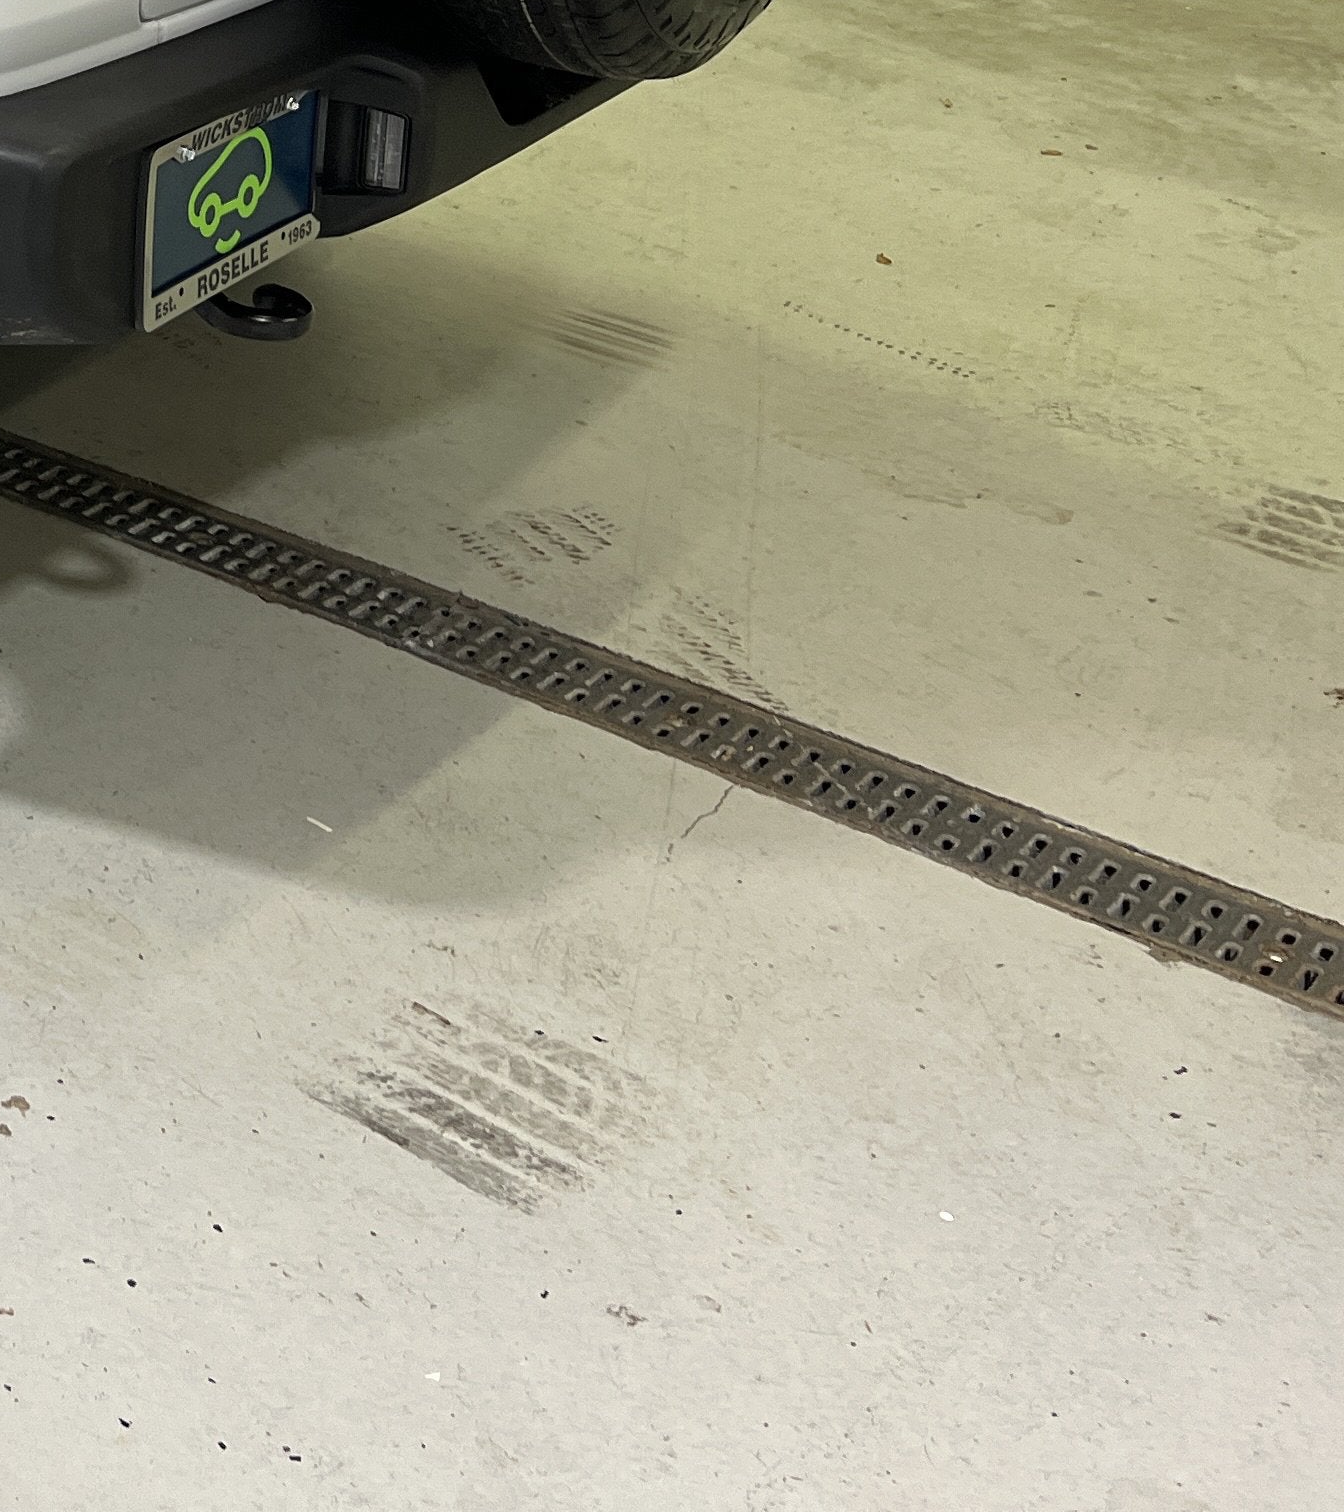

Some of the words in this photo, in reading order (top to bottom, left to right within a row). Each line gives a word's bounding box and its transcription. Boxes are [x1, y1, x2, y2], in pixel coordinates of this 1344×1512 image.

[155, 296, 177, 321] Est.
[197, 240, 269, 298] ROSELLE
[287, 220, 312, 246] 1963
